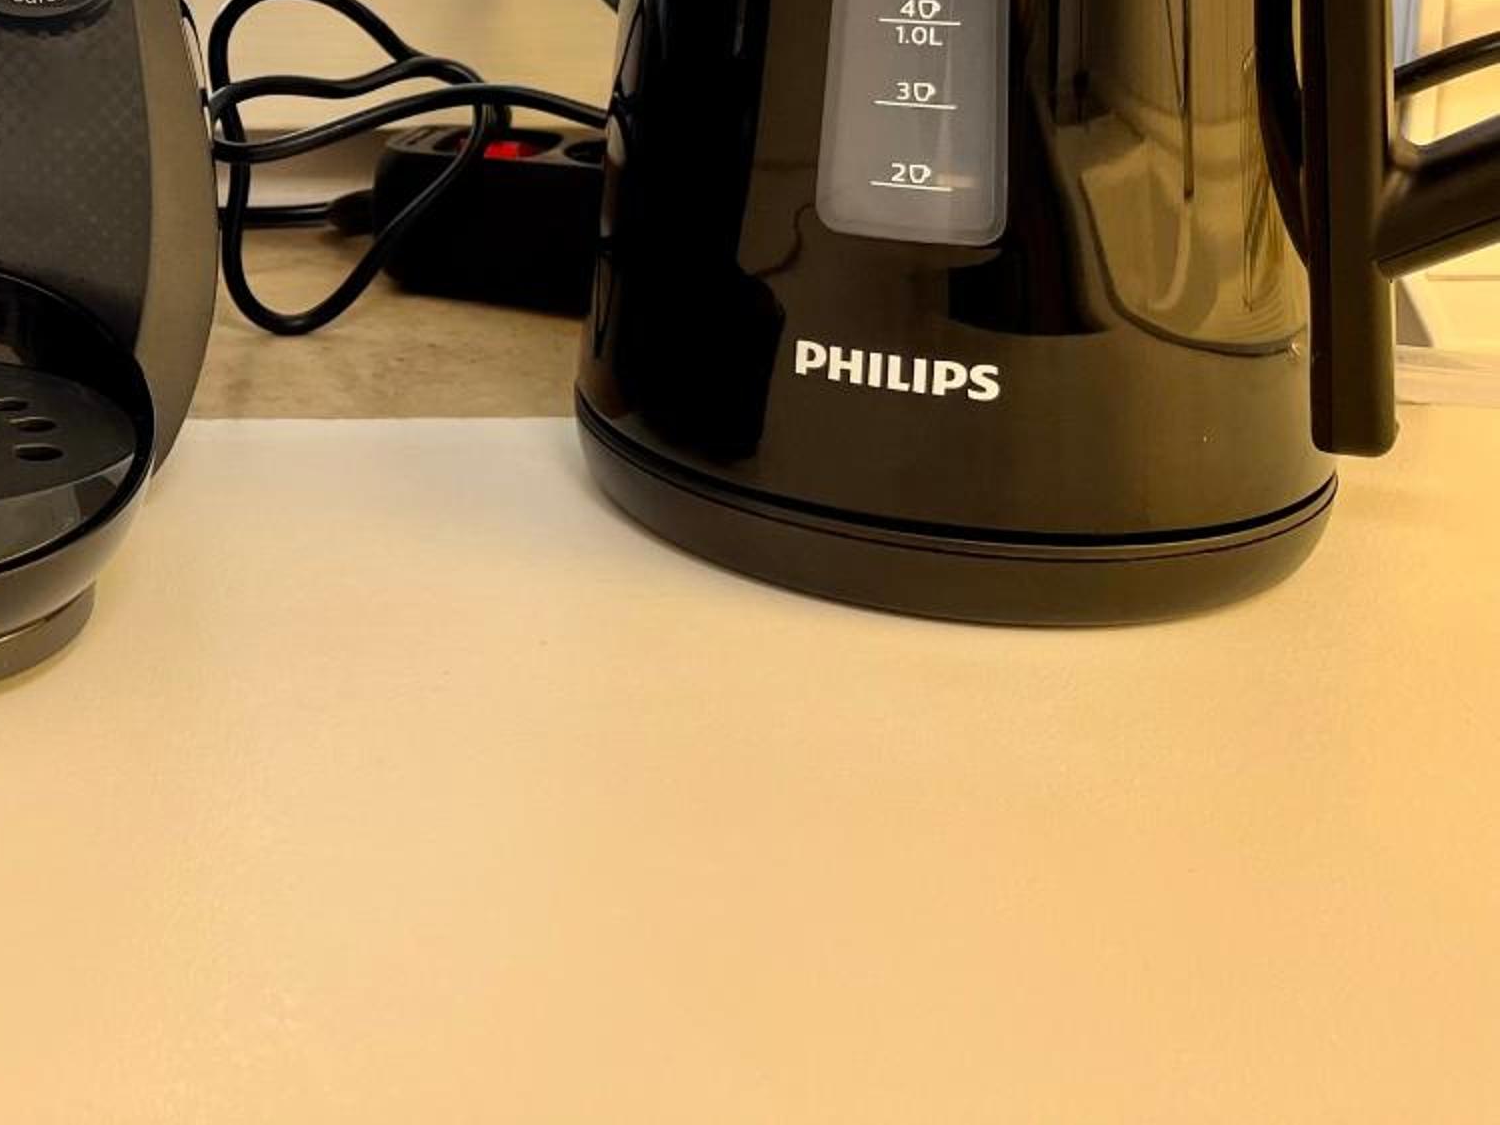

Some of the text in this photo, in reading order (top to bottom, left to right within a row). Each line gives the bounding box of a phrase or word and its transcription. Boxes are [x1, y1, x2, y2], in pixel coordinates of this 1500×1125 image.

[896, 25, 943, 46] 1.0L
[896, 82, 910, 100] 3
[891, 162, 906, 182] 2
[795, 340, 1001, 401] PHILIPS
